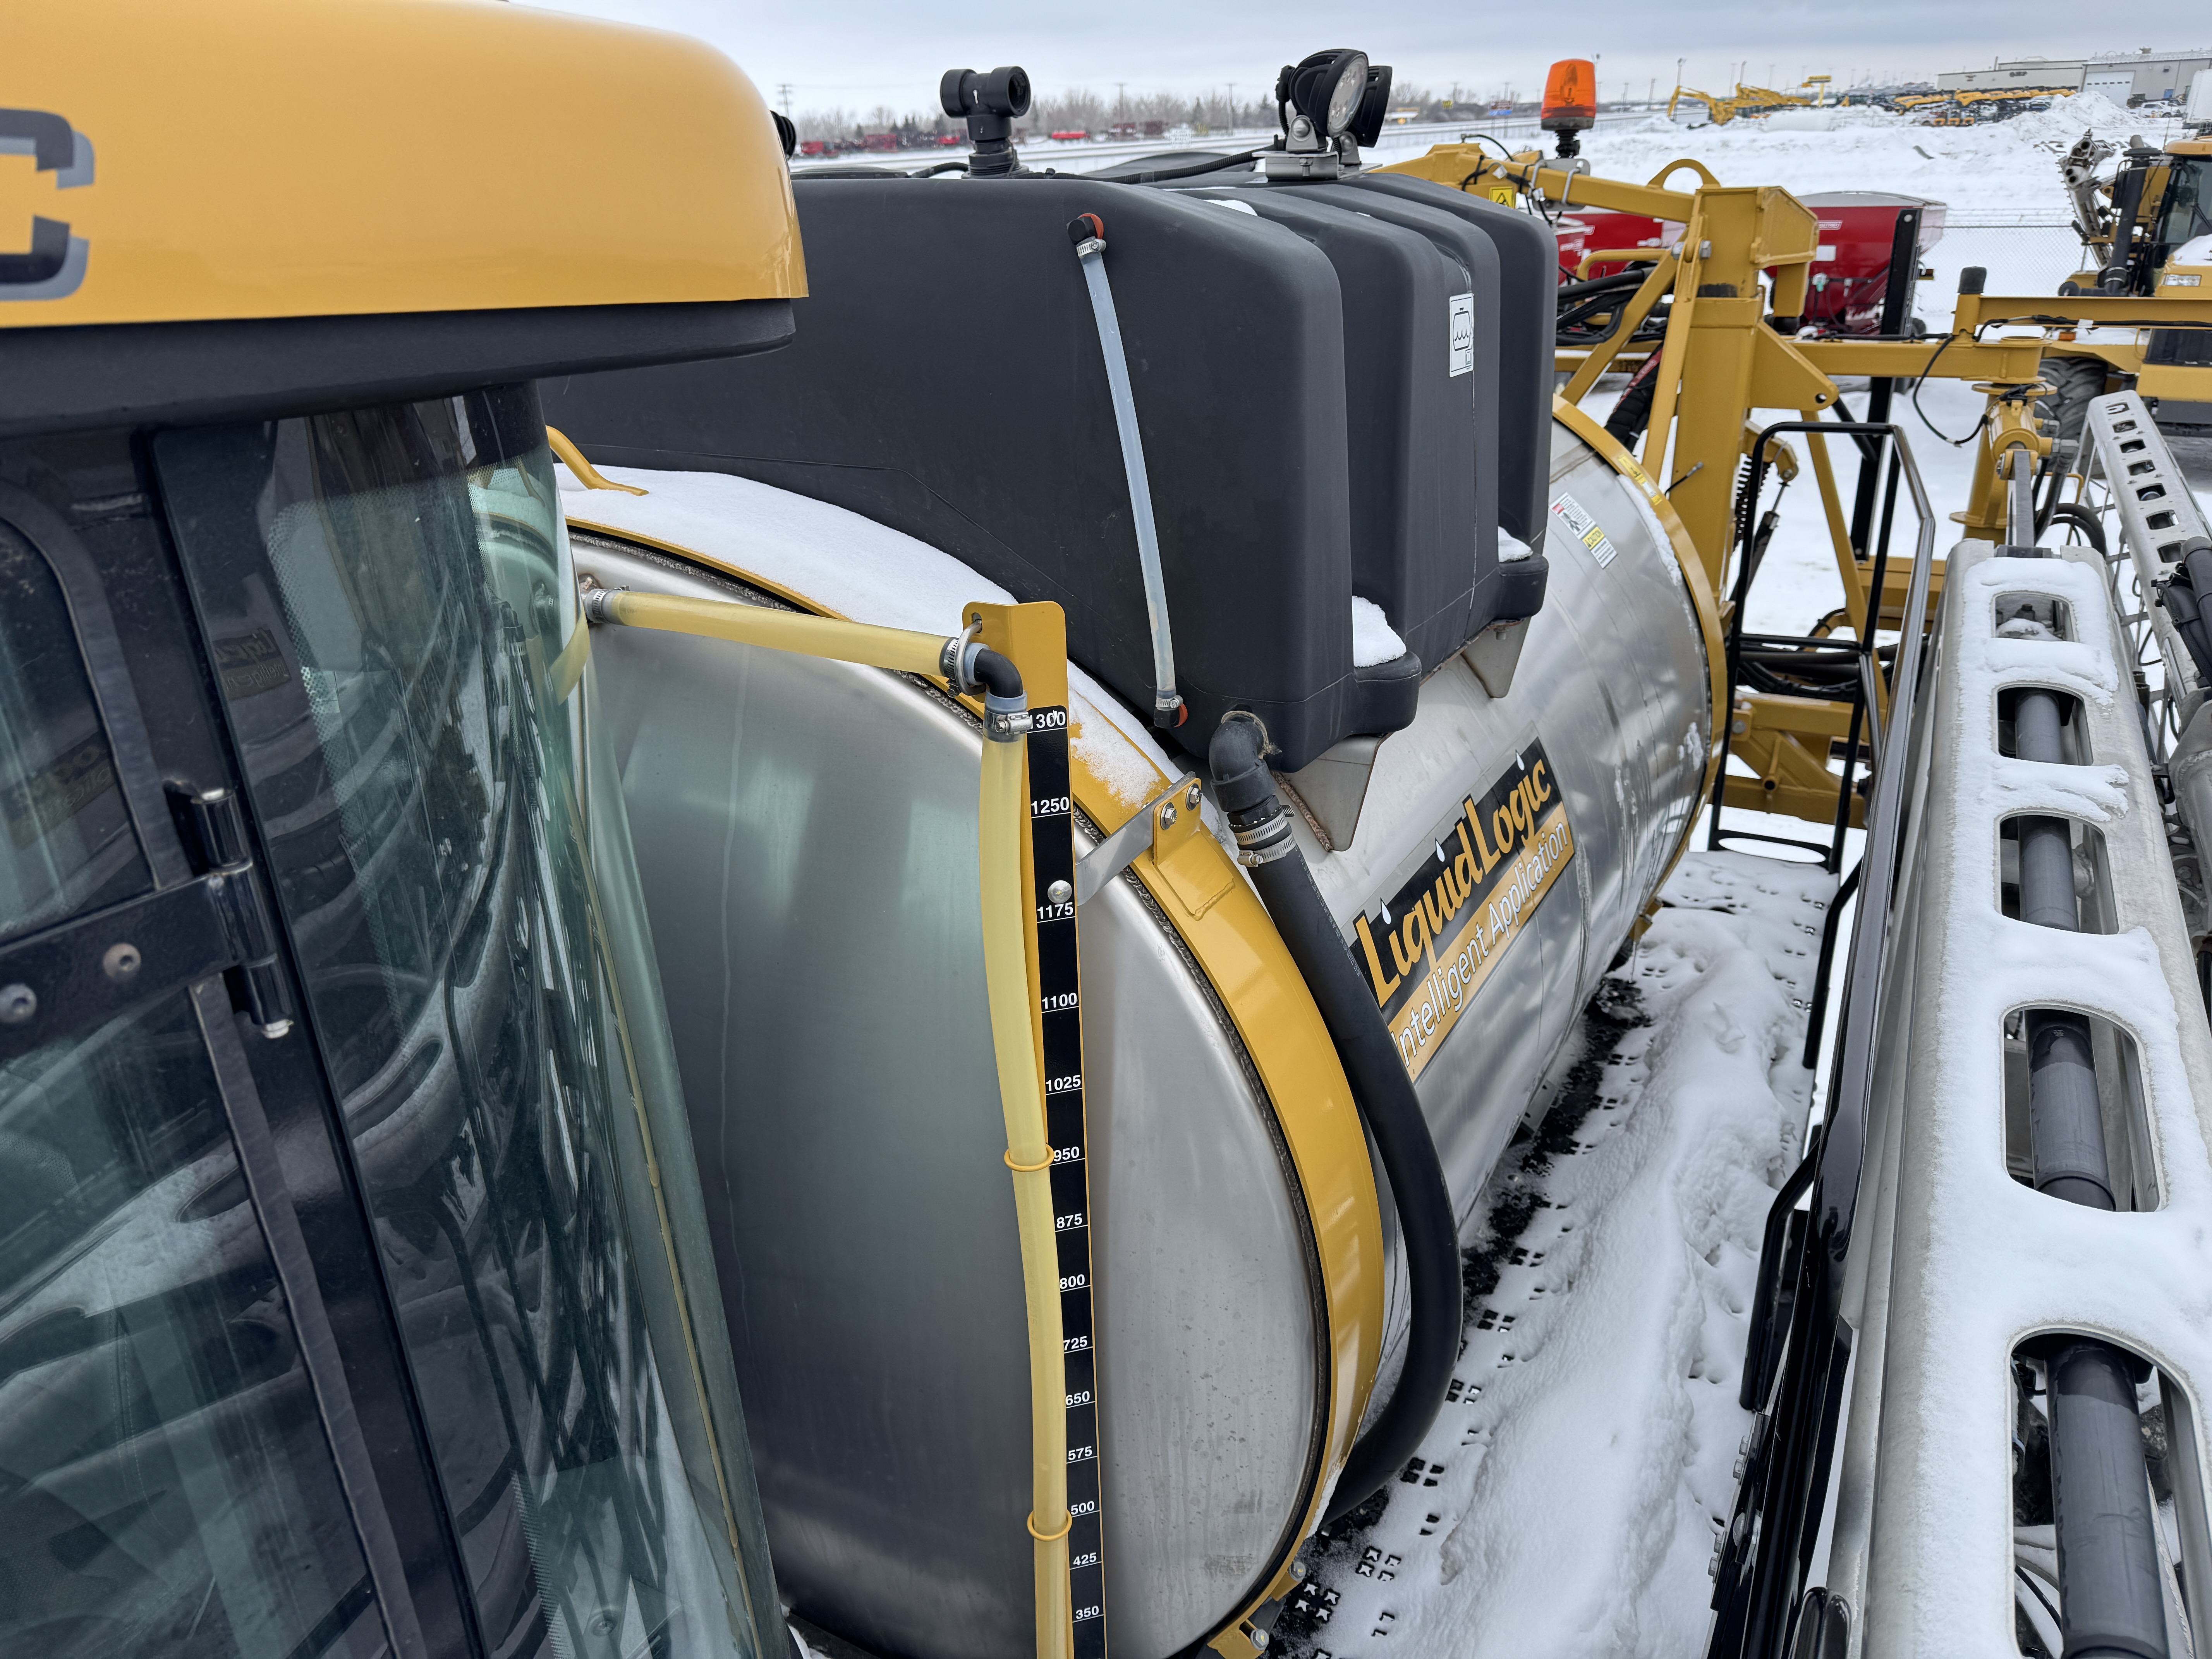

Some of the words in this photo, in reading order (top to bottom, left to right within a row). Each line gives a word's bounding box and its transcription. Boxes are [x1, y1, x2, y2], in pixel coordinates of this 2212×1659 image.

[1029, 710, 1066, 730] 1300
[1031, 797, 1070, 814] 1250
[1355, 750, 1551, 1008] LiquidLogic
[1487, 820, 1569, 946] Application
[1037, 902, 1074, 919] 1175
[1042, 992, 1077, 1010] 1100
[1046, 1074, 1081, 1092] 1025
[1054, 1146, 1080, 1162] 950
[1056, 1213, 1083, 1229] 875
[1059, 1274, 1085, 1290] 800
[1063, 1336, 1088, 1351] 725
[1065, 1391, 1090, 1406] 650
[1068, 1446, 1093, 1461] 575
[1070, 1501, 1095, 1515] 500
[1073, 1553, 1097, 1566] 425
[1075, 1606, 1099, 1620] 350
